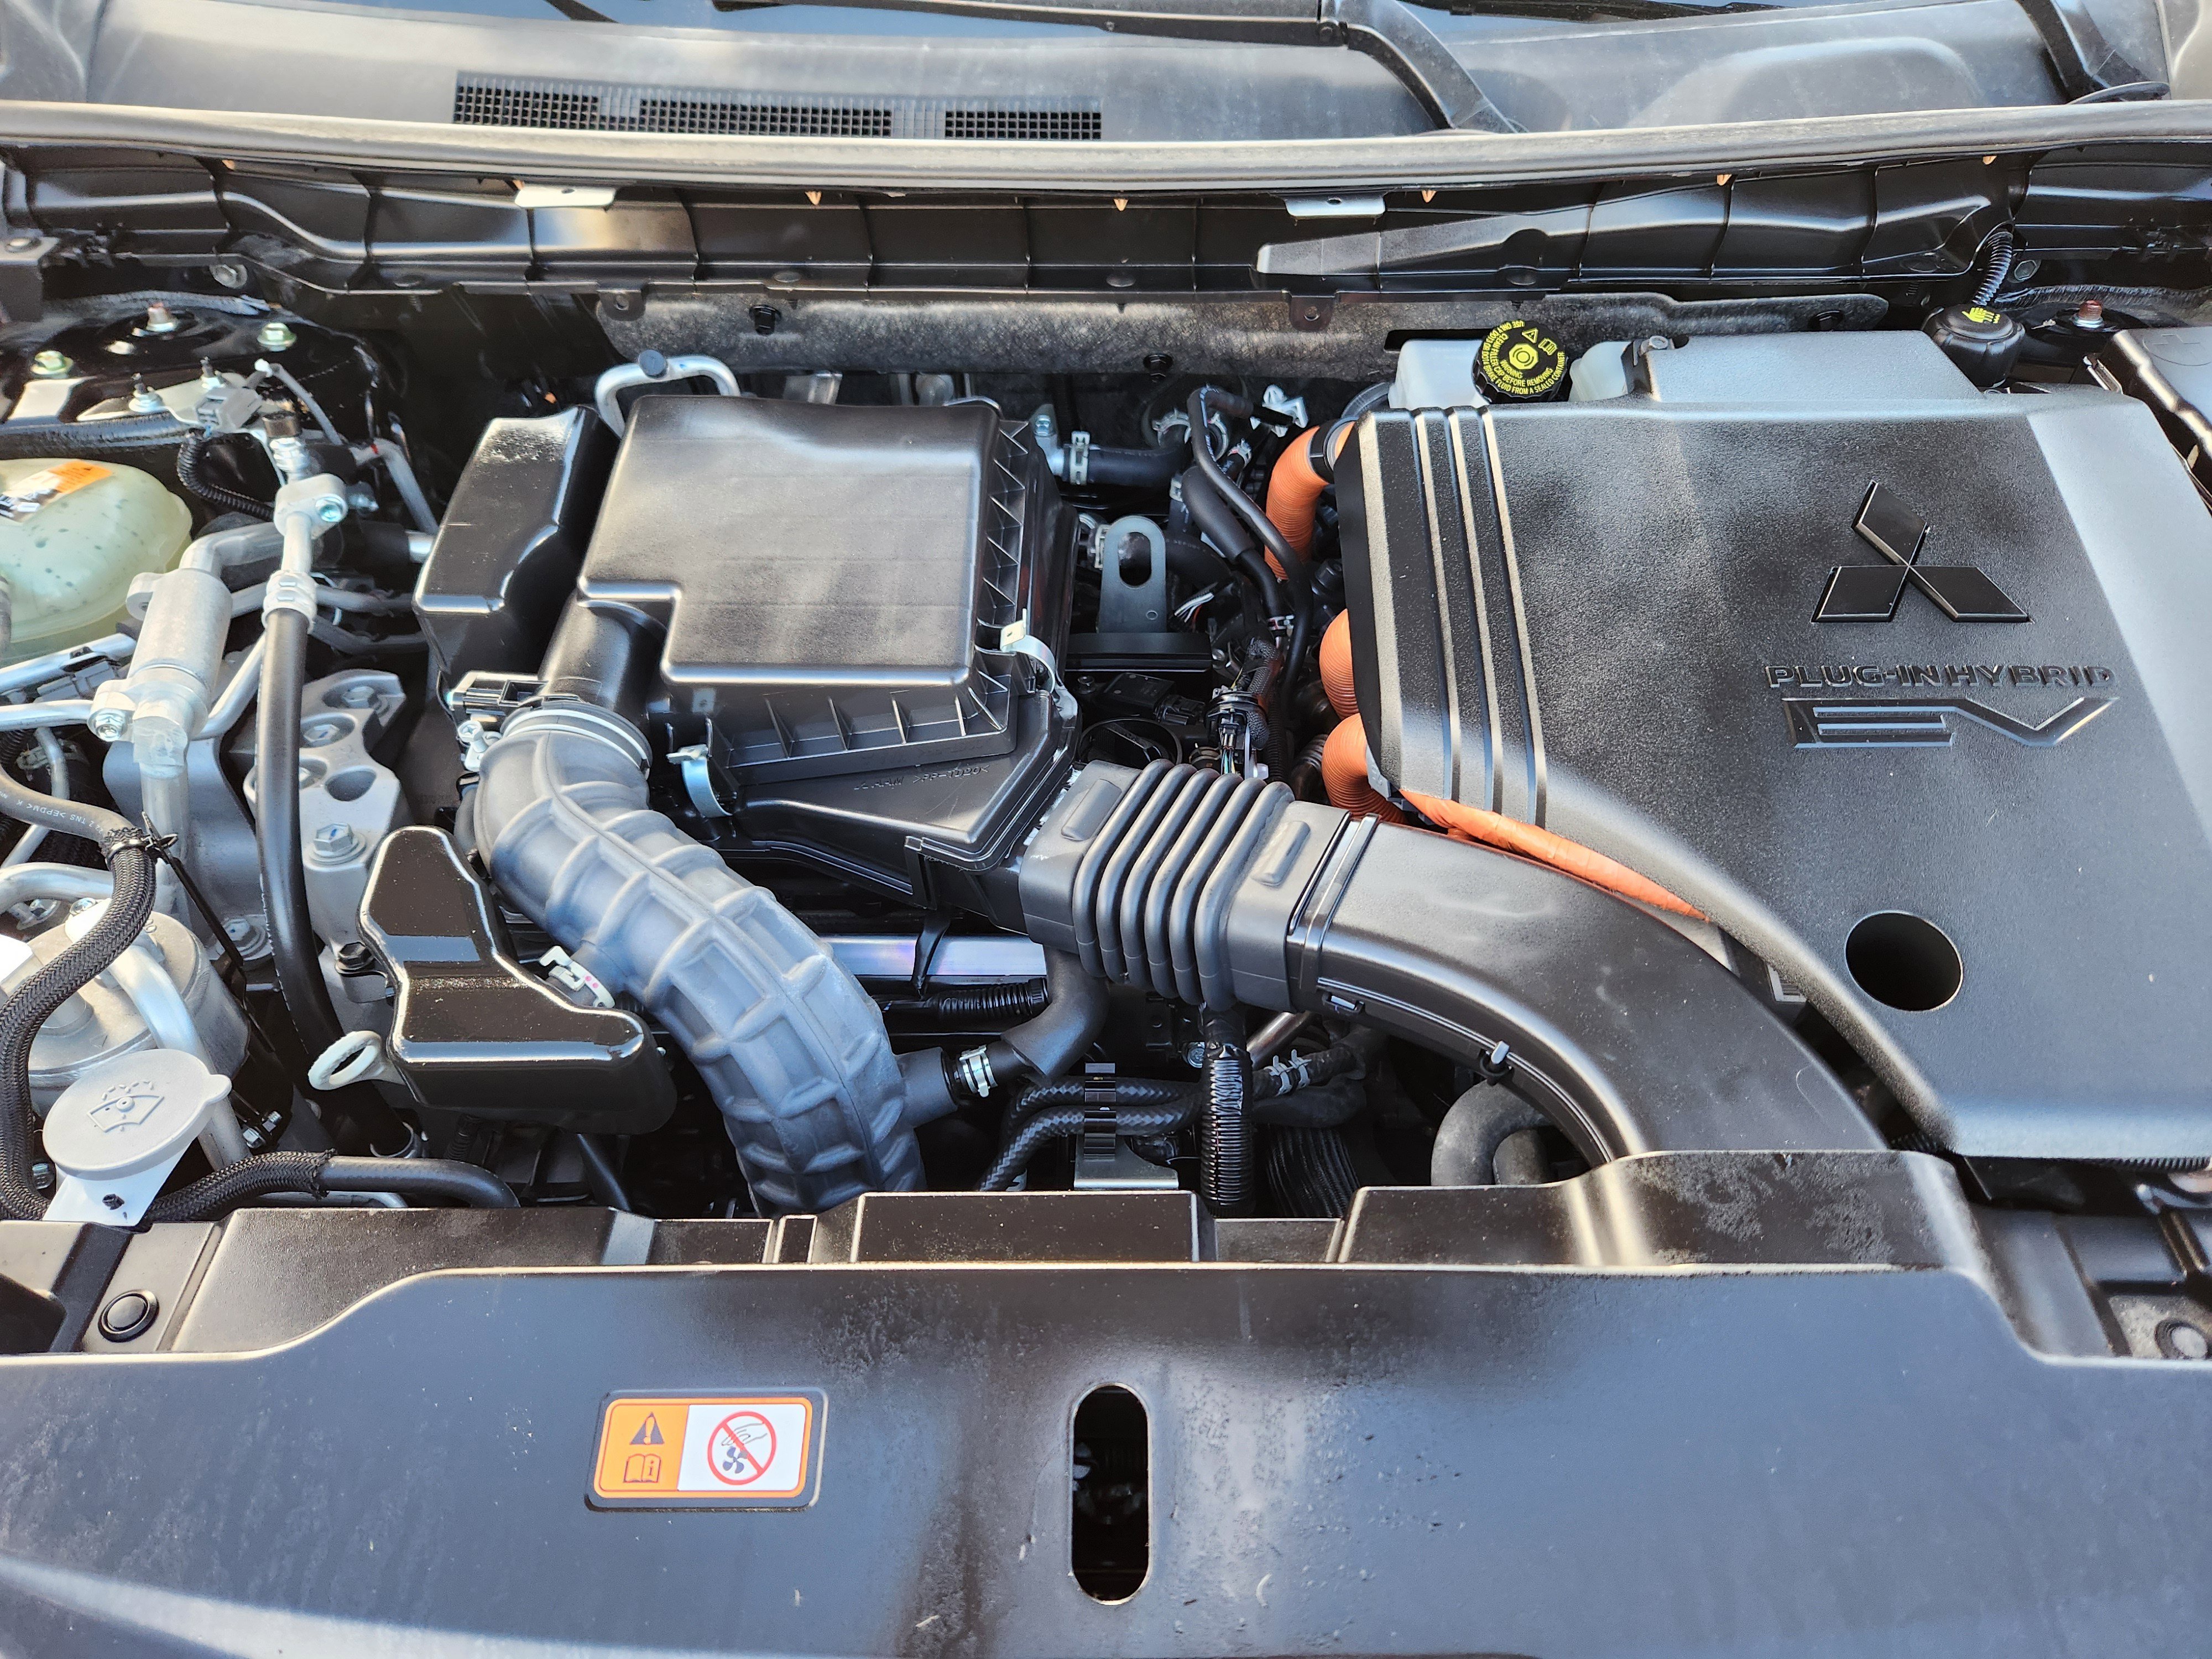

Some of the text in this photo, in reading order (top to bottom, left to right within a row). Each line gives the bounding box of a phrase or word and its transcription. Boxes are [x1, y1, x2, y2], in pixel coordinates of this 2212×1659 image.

[1497, 322, 1512, 333] ONLY
[1512, 320, 1525, 328] USE
[1483, 342, 1491, 351] OR
[1490, 333, 1553, 387] CLEAN FILLER CAP BEFORE REMOVING
[1551, 351, 1565, 380] CONTAINER
[1483, 364, 1497, 382] BRAKE
[1500, 359, 1523, 379] WARNING
[1495, 380, 1511, 392] FLUID
[1511, 386, 1528, 394] FROM
[1534, 379, 1554, 393] SEALED
[1766, 664, 2115, 688] PLUG-IN HYBRID
[1781, 696, 2120, 749] EV
[70, 814, 86, 825] TNS
